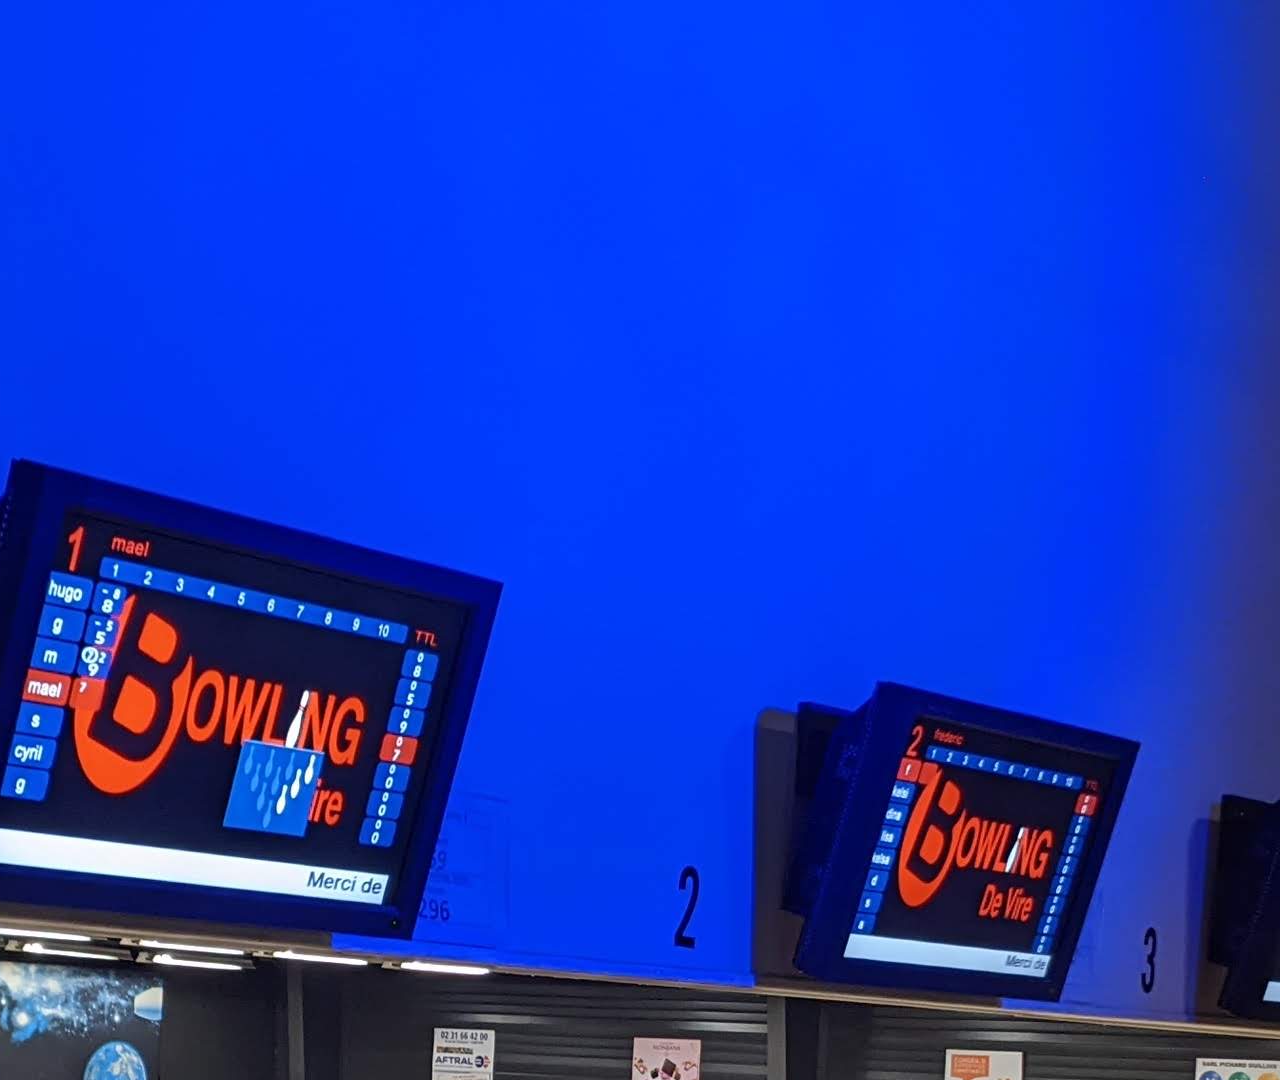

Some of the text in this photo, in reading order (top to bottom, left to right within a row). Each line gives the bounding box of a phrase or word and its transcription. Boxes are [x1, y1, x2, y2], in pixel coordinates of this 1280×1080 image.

[69, 526, 84, 571] 1
[111, 536, 149, 557] mael
[48, 578, 83, 603] hugo
[101, 599, 114, 613] 8
[113, 564, 389, 638] 1 2 3 4 5 6 7 8 9 10
[52, 617, 64, 635] g
[95, 631, 106, 645] 5
[415, 629, 438, 647] TTL
[43, 649, 58, 664] m
[417, 652, 424, 663] 0
[88, 663, 99, 677] 9
[413, 665, 421, 678] 8
[28, 680, 62, 698] mael
[79, 682, 88, 693] 7
[410, 681, 417, 691] 0
[406, 693, 415, 706] 5
[31, 714, 40, 728] s
[403, 709, 410, 719] 0
[399, 721, 408, 733] 9
[396, 736, 403, 747] 0
[906, 725, 923, 757] 2
[14, 745, 43, 763] cyril
[392, 750, 401, 761] 7
[389, 764, 396, 775] 0
[15, 778, 26, 794] g
[385, 776, 394, 788] 0
[308, 778, 344, 825] ire
[382, 792, 389, 802] 0
[378, 804, 386, 816] 0
[375, 819, 382, 830] 0
[371, 832, 379, 844] 0
[307, 871, 382, 894] Merci de
[674, 866, 699, 948] 2
[978, 883, 1035, 923] De Vire
[1005, 954, 1046, 970] Merci de
[1141, 927, 1157, 993] 3
[441, 1031, 449, 1039] 02
[451, 1032, 457, 1040] 31
[480, 1033, 488, 1041] 00
[435, 1056, 473, 1065] AFTRAL
